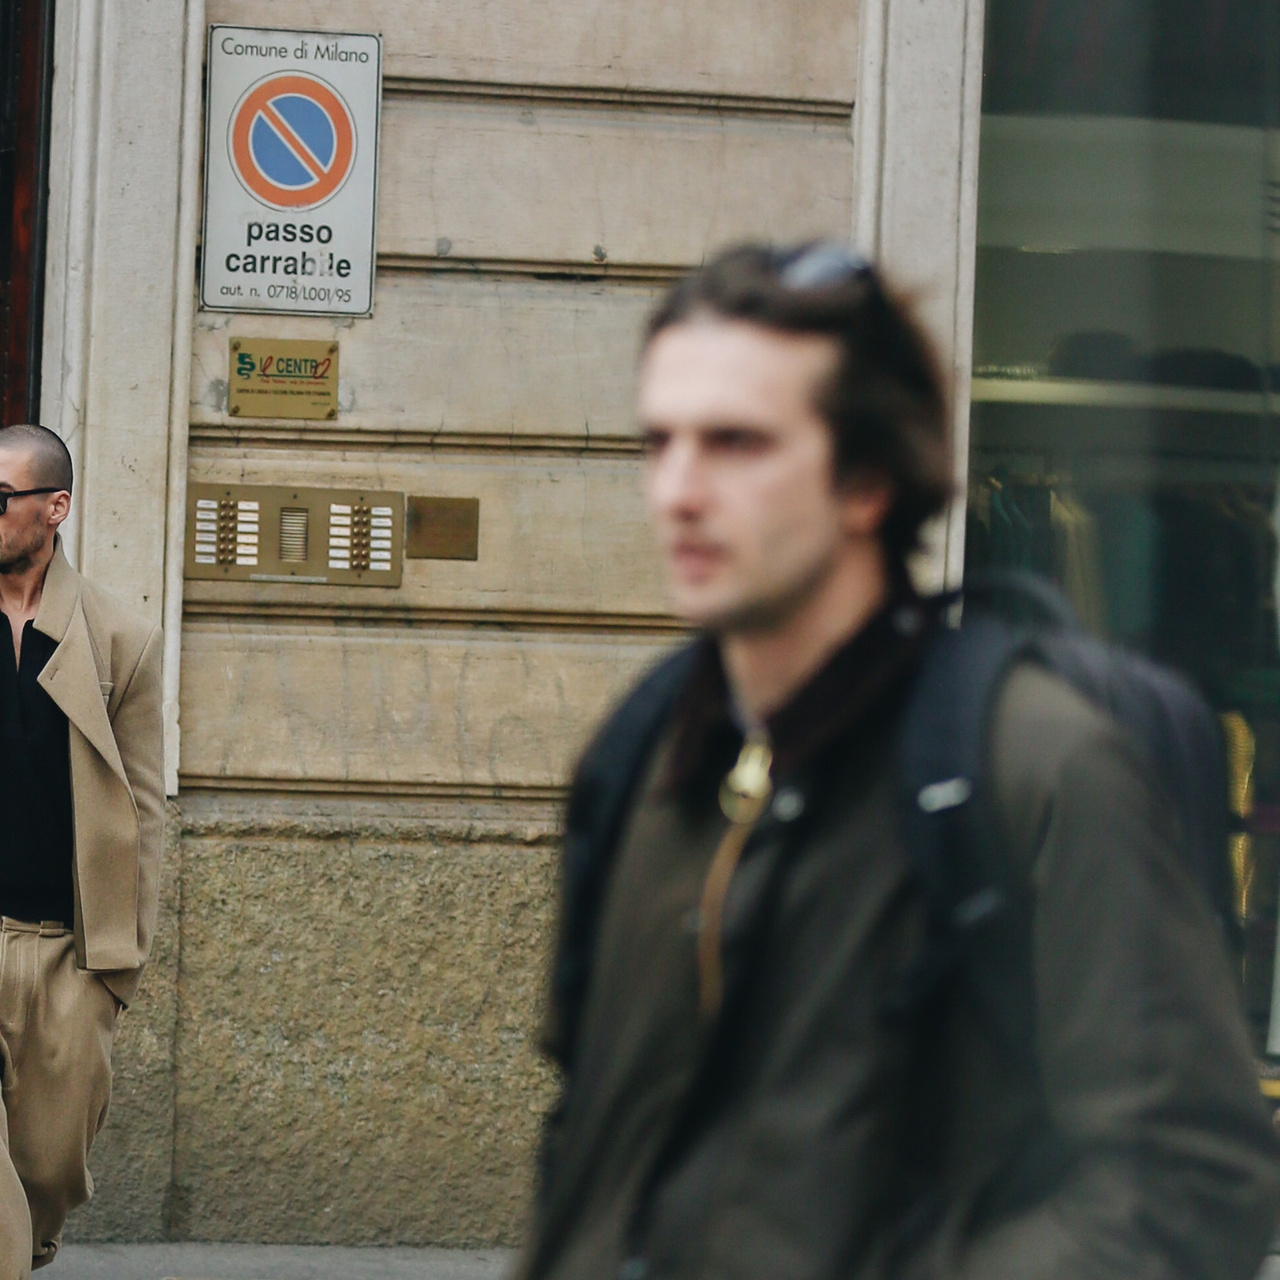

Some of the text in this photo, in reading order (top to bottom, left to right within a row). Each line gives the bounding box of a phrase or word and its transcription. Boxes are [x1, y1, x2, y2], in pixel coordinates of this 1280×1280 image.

[221, 37, 369, 63] Comune di Milano
[246, 221, 333, 247] passo
[225, 251, 351, 278] carrable
[220, 284, 243, 297] aut.
[249, 286, 260, 297] n.
[276, 357, 331, 379] CENTRO
